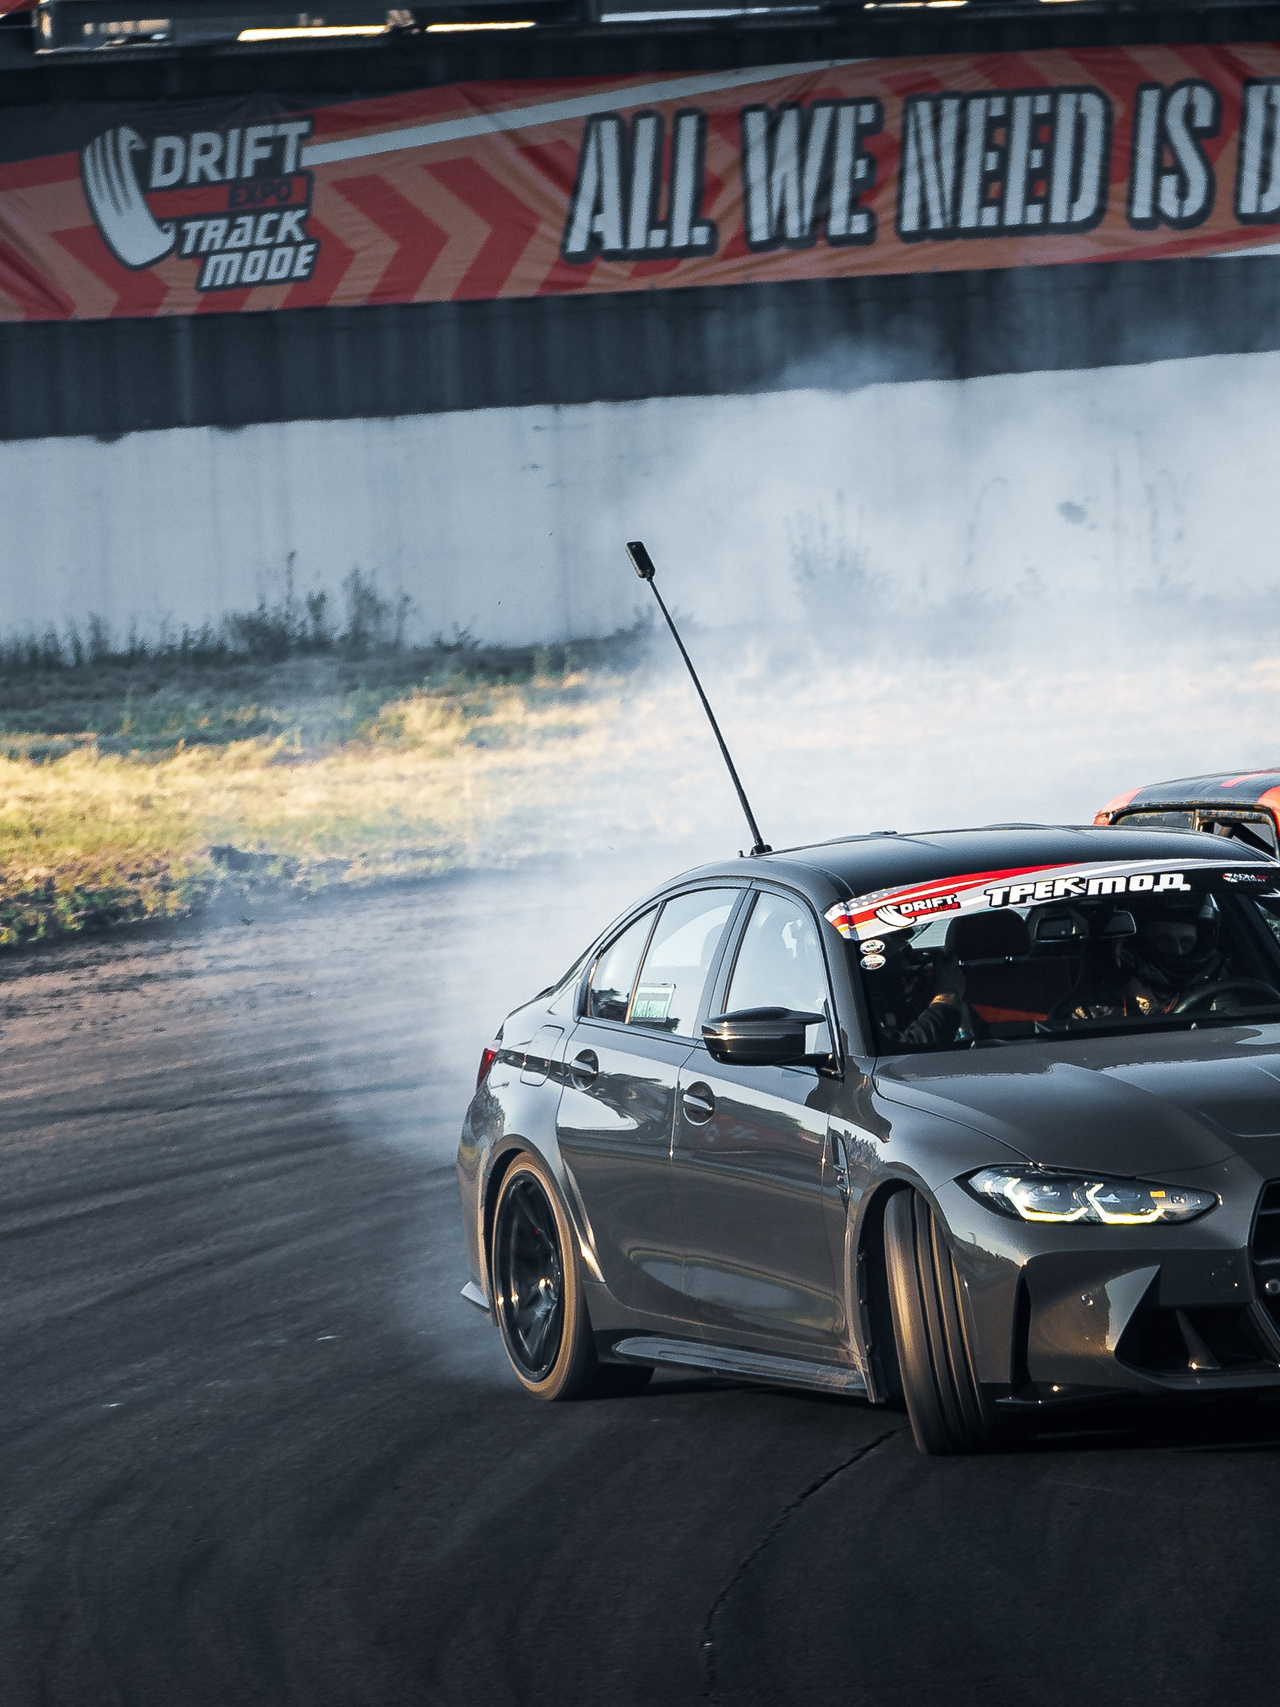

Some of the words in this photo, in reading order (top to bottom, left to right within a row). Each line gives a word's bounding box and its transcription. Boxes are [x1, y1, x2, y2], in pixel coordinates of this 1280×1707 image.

[149, 120, 312, 189] DRIFT
[564, 112, 710, 254] ALL
[744, 103, 877, 243] WE
[899, 89, 1105, 233] NEED
[1130, 84, 1217, 221] IS
[899, 894, 957, 915] DRIFT
